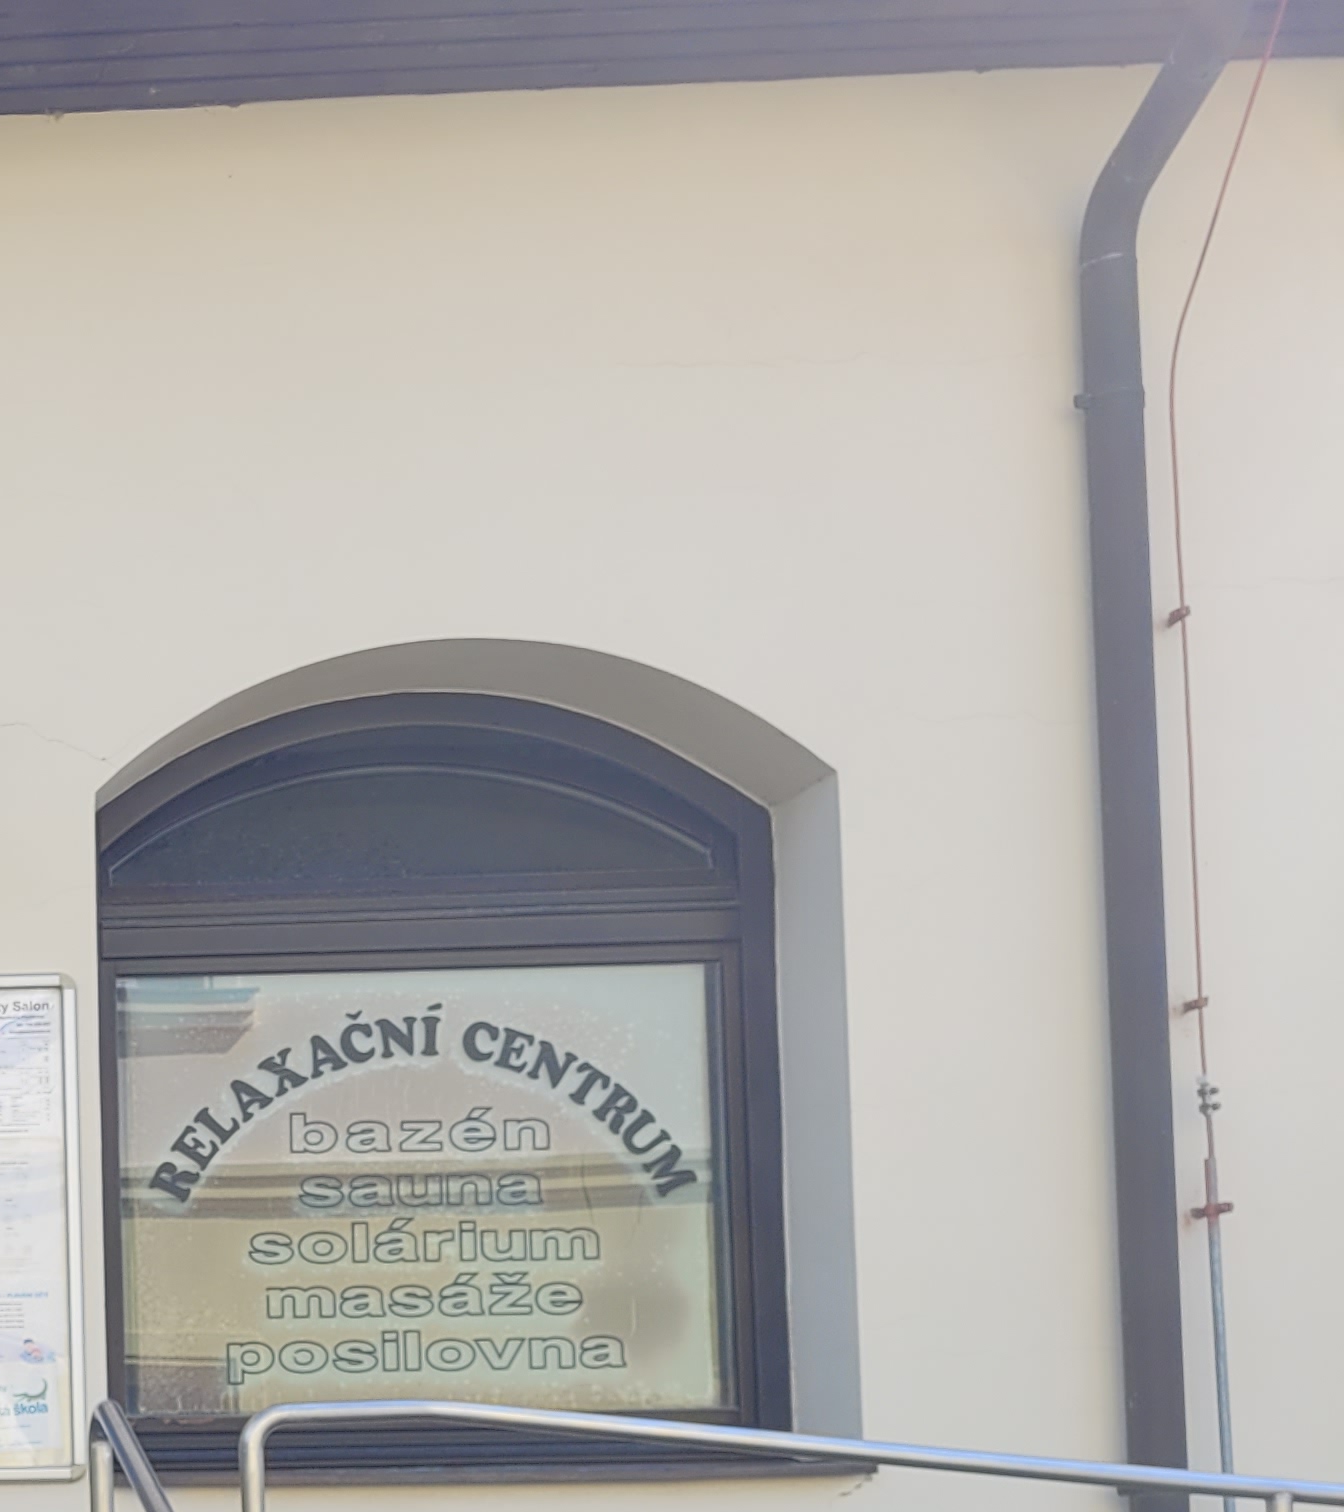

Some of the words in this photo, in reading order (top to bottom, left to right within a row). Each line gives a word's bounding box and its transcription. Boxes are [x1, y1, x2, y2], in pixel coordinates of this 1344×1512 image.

[13, 1001, 49, 1012] Salon
[148, 1003, 444, 1203] RELAXAČNÍ
[462, 1020, 698, 1198] CENTRUM
[289, 1107, 551, 1154] bazén
[299, 1172, 544, 1209] sauna
[248, 1217, 601, 1266] solárium
[265, 1271, 583, 1321] masáže
[226, 1329, 627, 1386] posilovna
